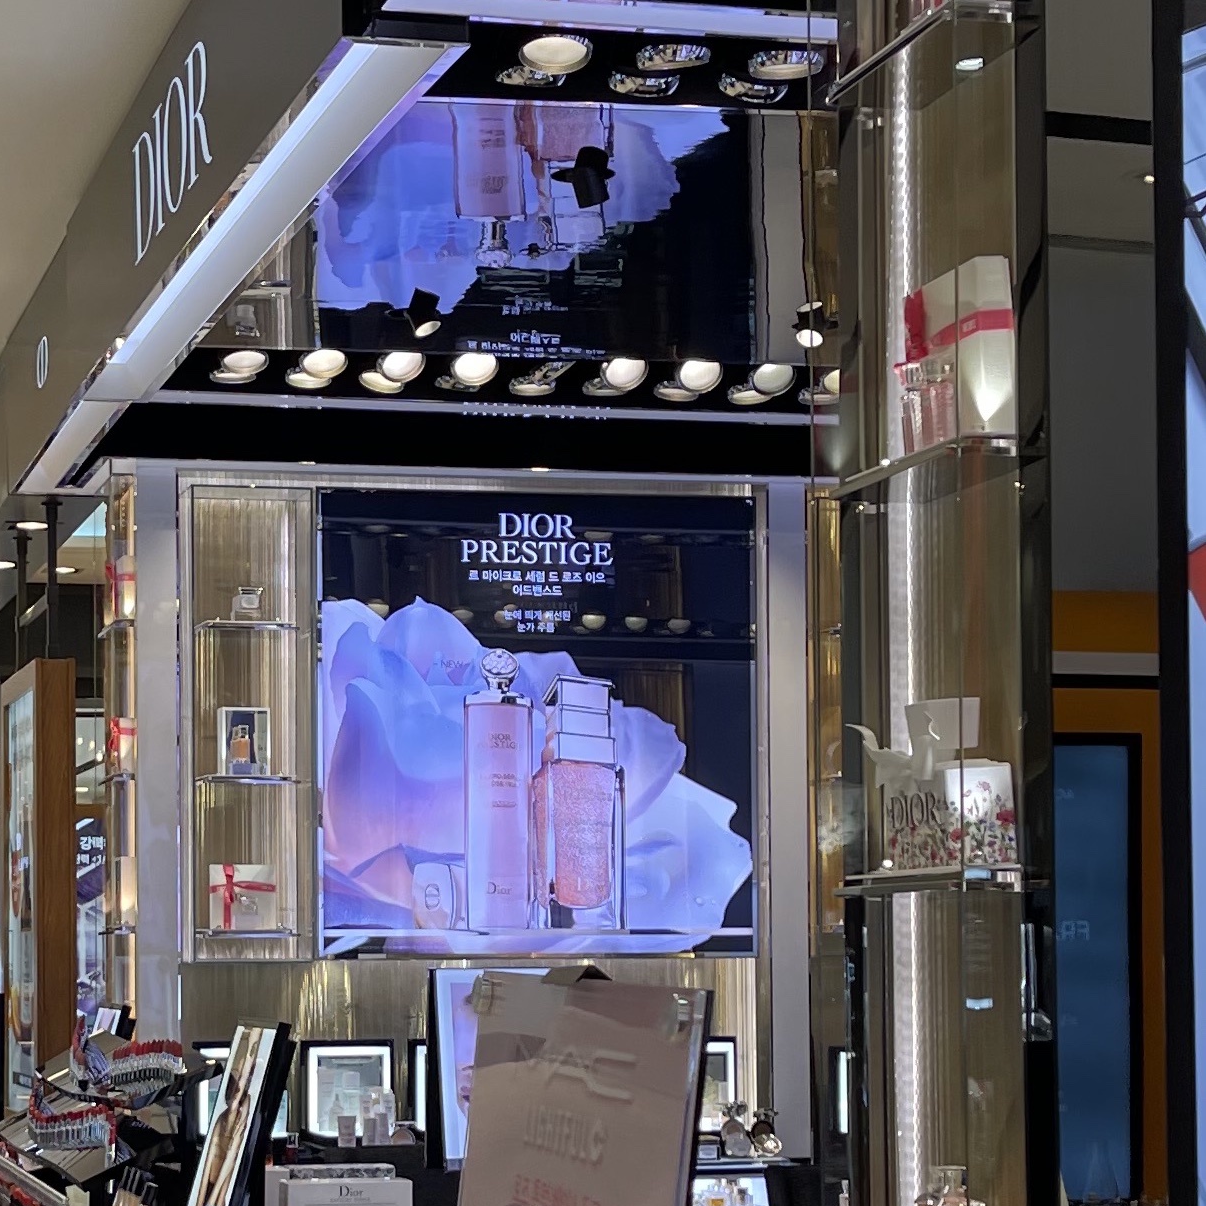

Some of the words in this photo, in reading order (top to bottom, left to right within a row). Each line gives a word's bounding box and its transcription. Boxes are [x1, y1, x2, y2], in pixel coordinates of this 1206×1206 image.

[132, 41, 212, 266] DIOR
[498, 512, 576, 540] DIOR
[460, 539, 614, 566] PRESTIGE
[482, 569, 522, 583] 마이크로
[525, 570, 545, 583] 세럼
[548, 571, 560, 583] 드
[561, 571, 583, 583] 로즈
[890, 792, 943, 829] DIOR
[486, 881, 512, 895] Dior
[339, 1185, 364, 1197] Dior
